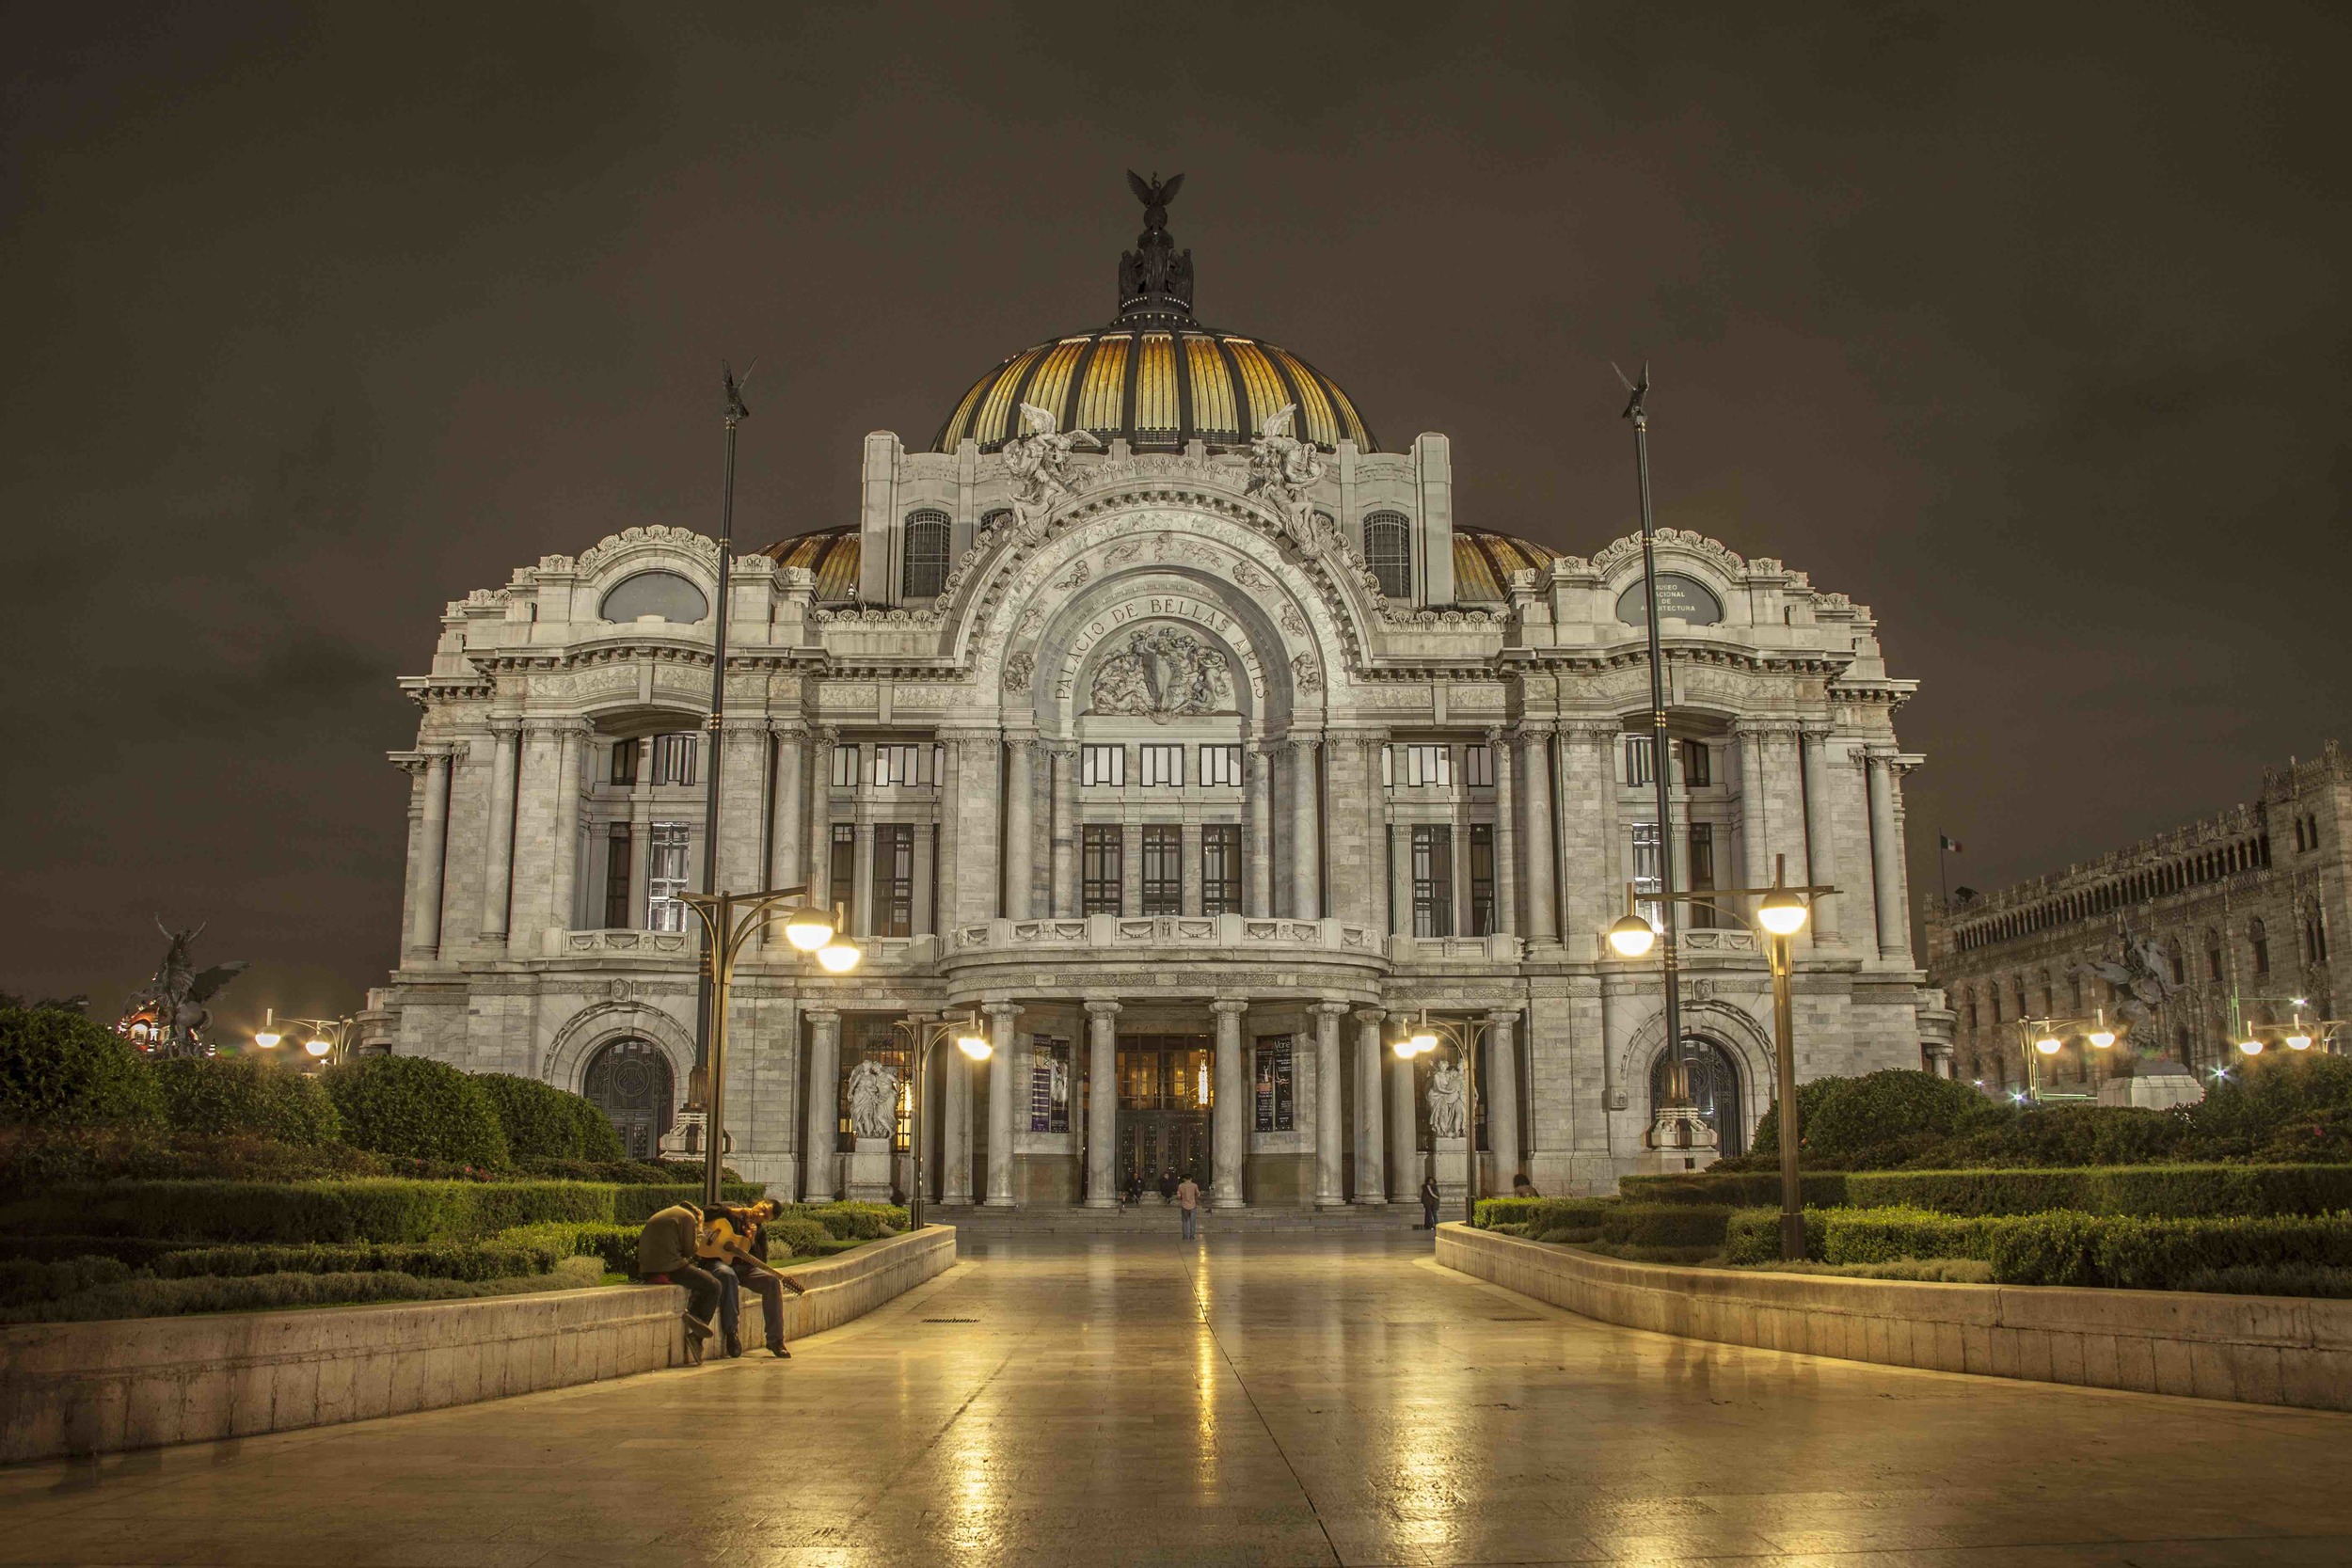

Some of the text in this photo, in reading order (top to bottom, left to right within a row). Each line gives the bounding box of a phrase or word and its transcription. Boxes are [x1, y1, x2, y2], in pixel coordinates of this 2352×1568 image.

[1055, 598, 1270, 700] PALACIO DE BELLAS ARTES
